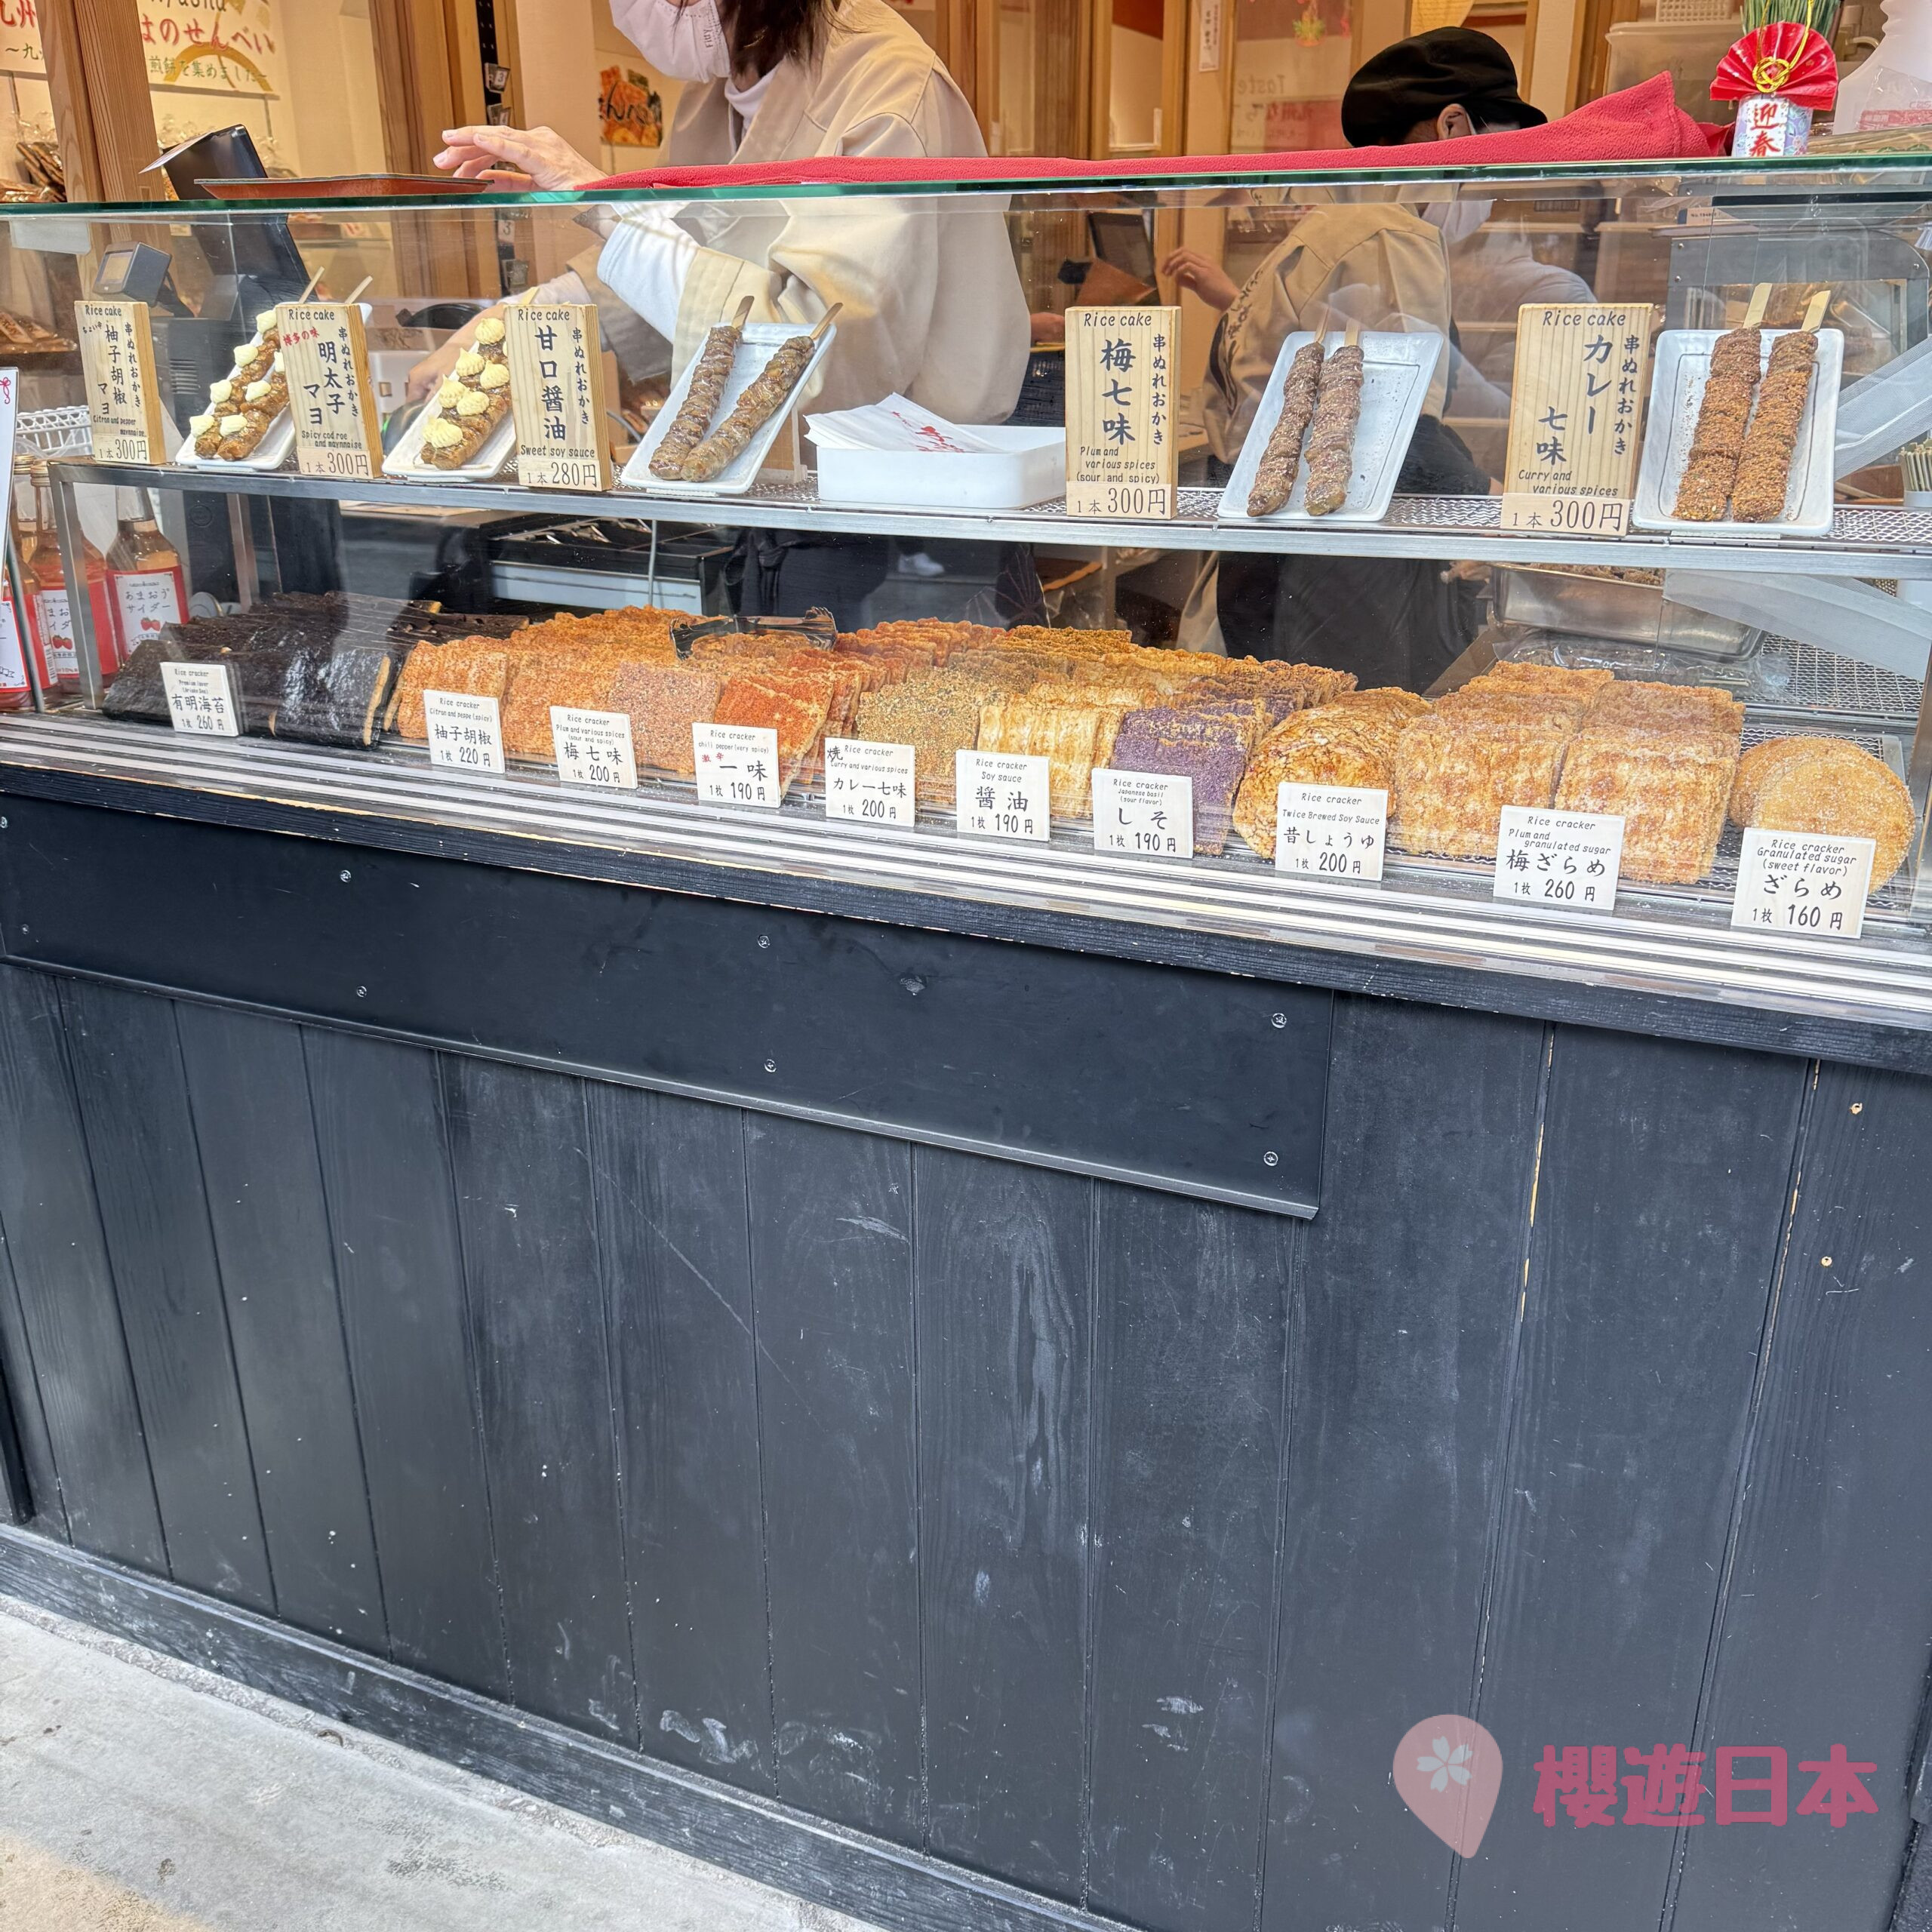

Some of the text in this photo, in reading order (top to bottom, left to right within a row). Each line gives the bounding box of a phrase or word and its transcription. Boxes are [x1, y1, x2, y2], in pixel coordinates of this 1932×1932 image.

[1749, 103, 1780, 157] 迎春
[85, 305, 122, 316] Rice cake
[289, 309, 334, 320] Rice cake
[518, 309, 570, 321] Rice cake
[1084, 312, 1152, 326] Rice cake
[1543, 311, 1626, 326] Rice cake
[283, 326, 320, 346] 博多の味
[105, 324, 128, 405] 柚子胡椒
[125, 322, 141, 408] 串ぬれおかき
[338, 327, 358, 417] 串ぬれおかき
[318, 341, 345, 414] 明太子
[534, 325, 566, 441] 甘口醤油
[572, 328, 589, 425] 串ぬれおかき
[1583, 334, 1614, 435] カレー
[98, 383, 109, 414] マヨ
[1100, 338, 1136, 445] 梅七味
[1152, 334, 1167, 445] 串ぬれおかき
[1615, 334, 1639, 455] 串ぬれおかき
[303, 383, 322, 425] マヨ
[94, 415, 109, 423] Citron
[302, 430, 321, 440] Spicy
[323, 431, 335, 439] cod
[1537, 406, 1568, 466] 七味
[115, 439, 147, 460] 300円
[521, 445, 595, 457] Sweet soy sauce
[1081, 446, 1118, 456] Plum and
[328, 452, 369, 475] 300円
[1085, 459, 1155, 469] various spices
[551, 462, 598, 488] 280円
[1076, 472, 1159, 484] (sour and spicy)
[1518, 469, 1572, 481] Curry and
[1533, 485, 1618, 497] various spices
[1108, 488, 1165, 515] 300円
[1551, 500, 1623, 531] 300円
[127, 603, 171, 613] サイダー
[172, 694, 223, 713] 有明海苔
[440, 697, 454, 706] Rice
[435, 724, 492, 745] 柚子胡椒
[711, 730, 725, 738] Rice
[564, 742, 623, 765] 梅七味
[827, 746, 843, 762] 焼
[844, 745, 893, 756] Rice cracker
[719, 761, 768, 781] 一味
[976, 758, 993, 767] Rice
[982, 771, 1022, 783] Soy sauce
[1114, 779, 1168, 790] Rice cracker
[833, 777, 906, 798] カレー七味
[976, 786, 1029, 812] 醤油
[1301, 793, 1362, 804] Rice cracker
[1118, 808, 1167, 829] しそ
[1283, 810, 1380, 824] Twice Brewed Soy Sauce
[1527, 817, 1595, 829] Rice cracker
[1284, 826, 1374, 849] 昔しょうゆ
[1509, 829, 1550, 840] Plum and
[1524, 840, 1611, 854] granulated sugar
[1757, 848, 1857, 864] Granulated sugar
[1771, 840, 1844, 854] Rice cracker
[1506, 849, 1605, 876] 梅ざらめ
[1763, 859, 1847, 876] (sweet flavor)
[1764, 875, 1841, 900] ざらめ
